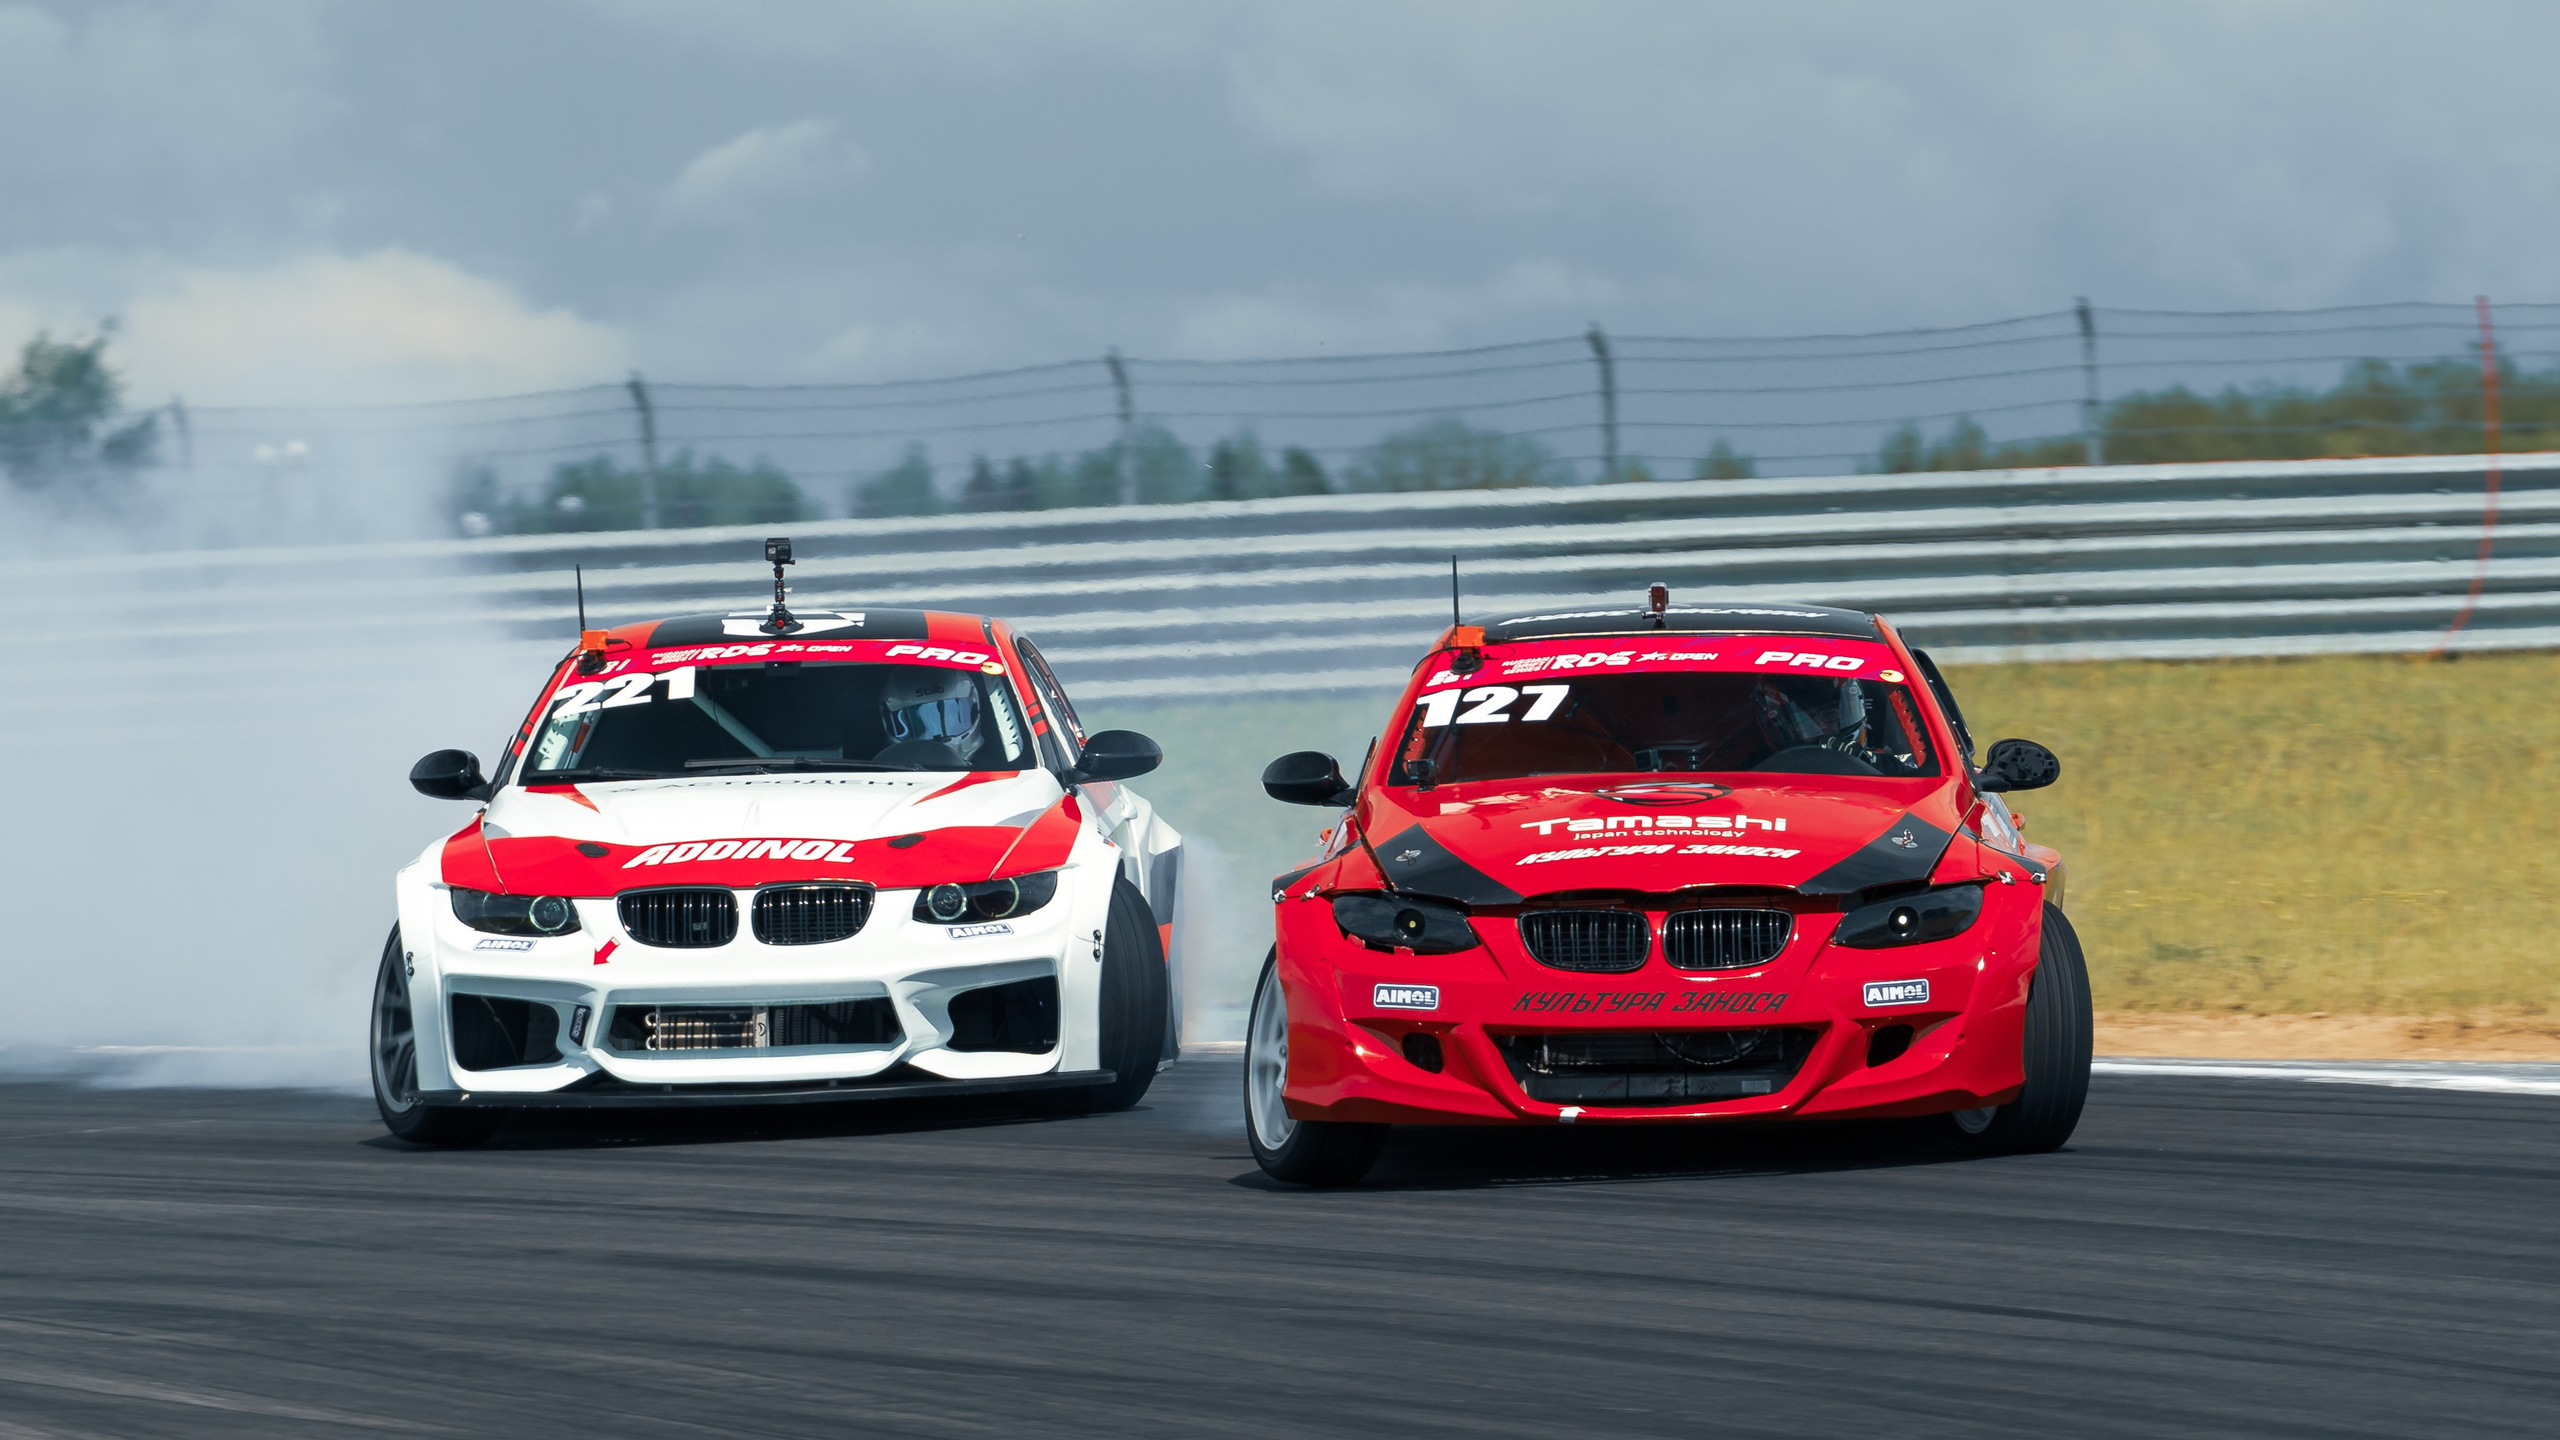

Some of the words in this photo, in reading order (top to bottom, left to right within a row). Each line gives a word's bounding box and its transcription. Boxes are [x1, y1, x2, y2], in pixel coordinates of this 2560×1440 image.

[696, 643, 776, 660] RDS
[806, 645, 853, 653] OPEN
[885, 644, 989, 665] PRO
[1551, 650, 1637, 670] RDS
[1669, 653, 1719, 661] OPEN
[1754, 651, 1865, 670] PRO
[552, 665, 696, 719] 221
[1416, 684, 1570, 727] 127
[1520, 814, 1787, 836] Tamashi
[1573, 830, 1628, 841] japan
[1633, 829, 1745, 838] technology
[621, 839, 855, 869] ADDINOL
[1515, 844, 1676, 865] КУЛЬТУРА
[1676, 844, 1801, 859] ЗАНОСА
[952, 924, 1009, 938] AIMOL
[475, 940, 531, 950] AIMOL
[1376, 989, 1435, 1005] AIMOL
[1512, 990, 1668, 1013] КУЛЬТУРА
[1671, 990, 1789, 1013] ЗАНОСА
[1867, 984, 1927, 1001] AIMOL
